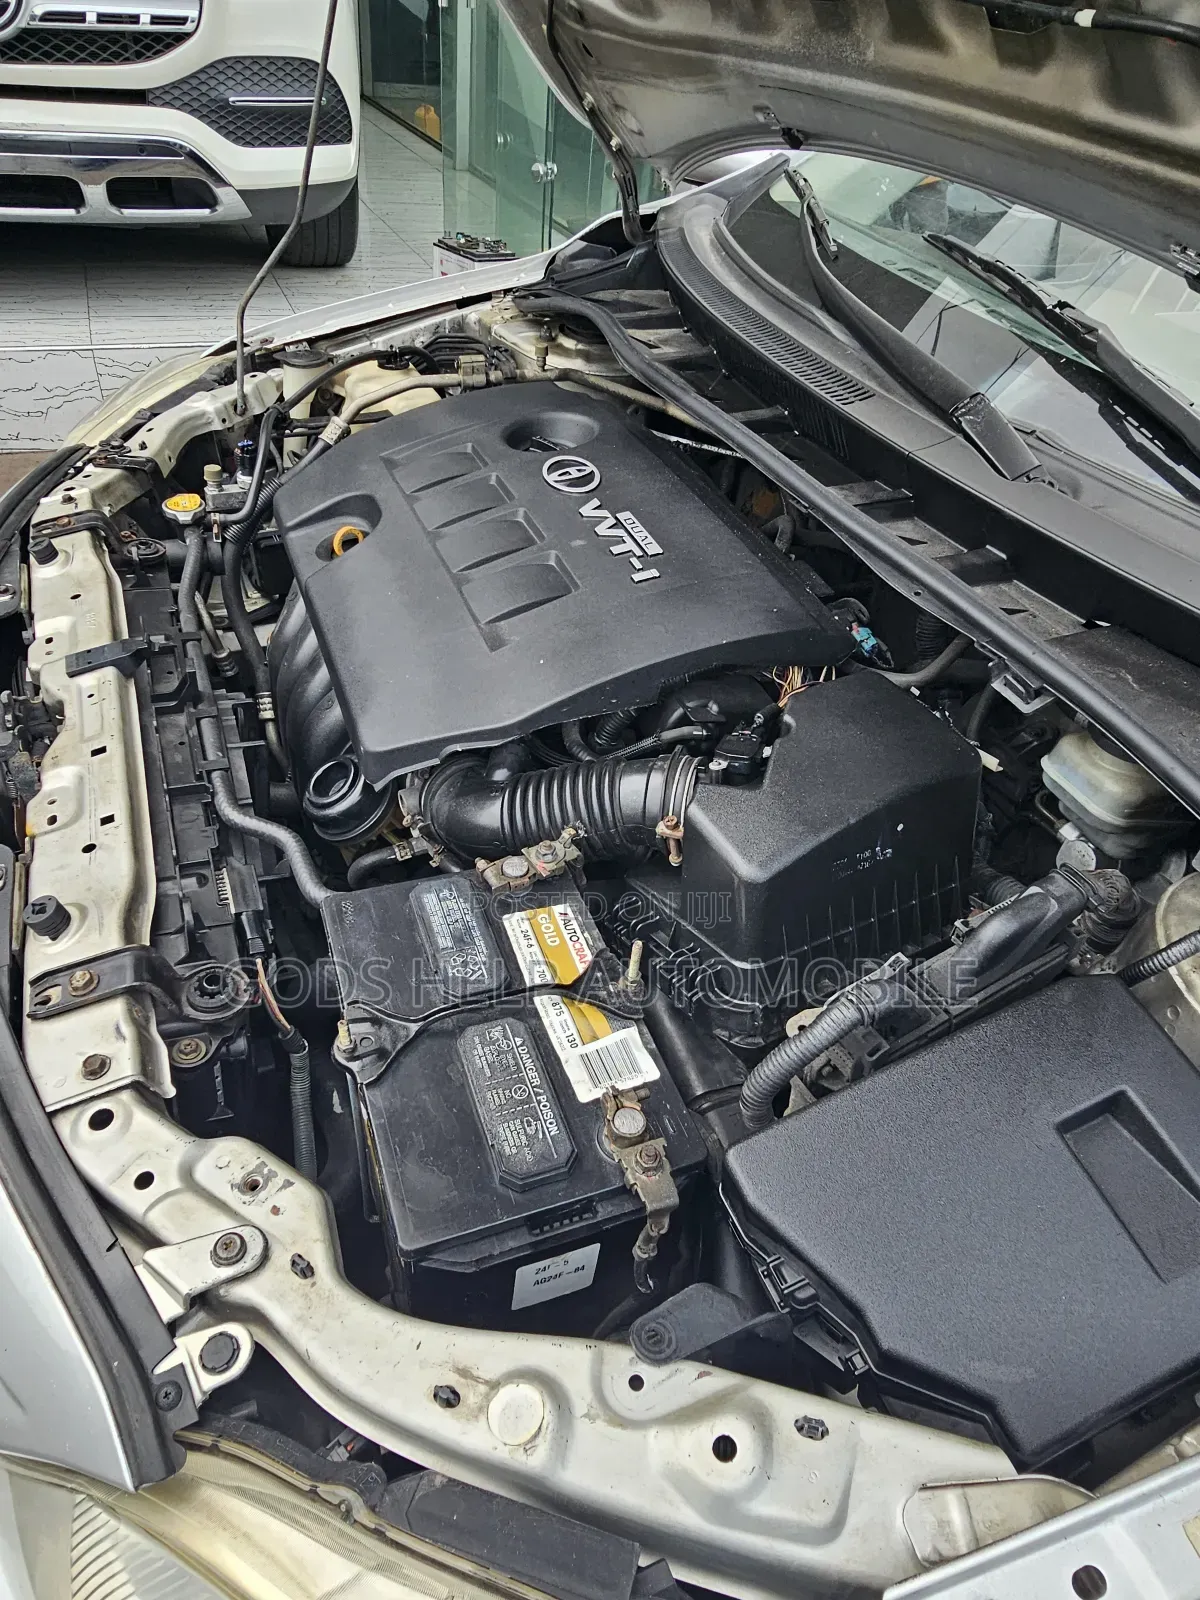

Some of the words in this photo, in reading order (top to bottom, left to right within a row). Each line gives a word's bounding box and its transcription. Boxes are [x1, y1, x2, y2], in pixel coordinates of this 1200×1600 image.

[623, 516, 654, 551] DUAL
[520, 929, 534, 949] 24F-6
[537, 913, 560, 947] GOLD
[560, 918, 593, 972] AUTOCRAF
[551, 1001, 565, 1017] 875
[565, 1032, 579, 1049] 130
[517, 1046, 541, 1087] DANGER
[536, 1095, 560, 1136] POISON
